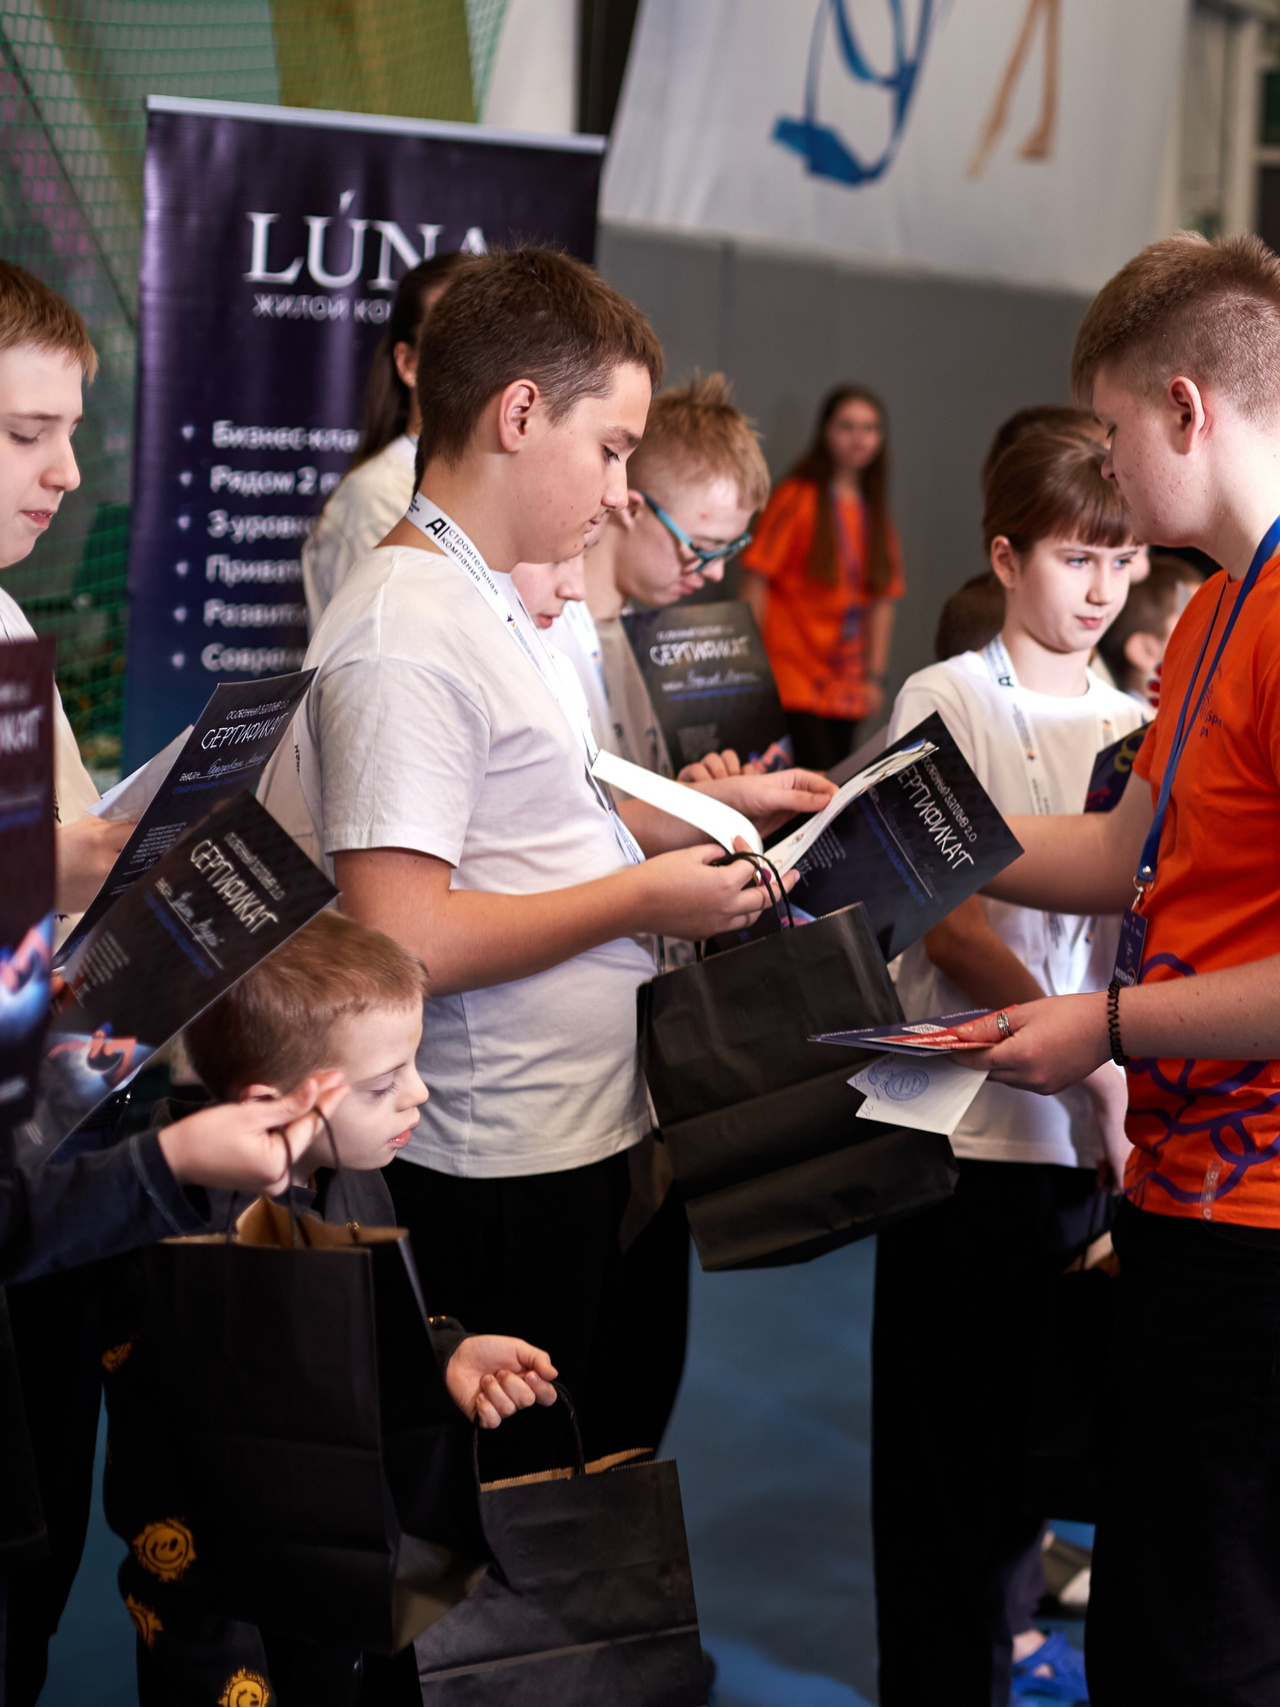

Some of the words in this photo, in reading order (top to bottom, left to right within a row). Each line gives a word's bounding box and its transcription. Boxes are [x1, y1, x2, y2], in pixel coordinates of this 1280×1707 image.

[212, 420, 359, 449] Бизнес-кла
[201, 713, 289, 750] СЕРТИФИКАТ
[898, 764, 974, 869] ЕРТИФИКАТ
[191, 839, 278, 933] СЕРТИФИКАТ
